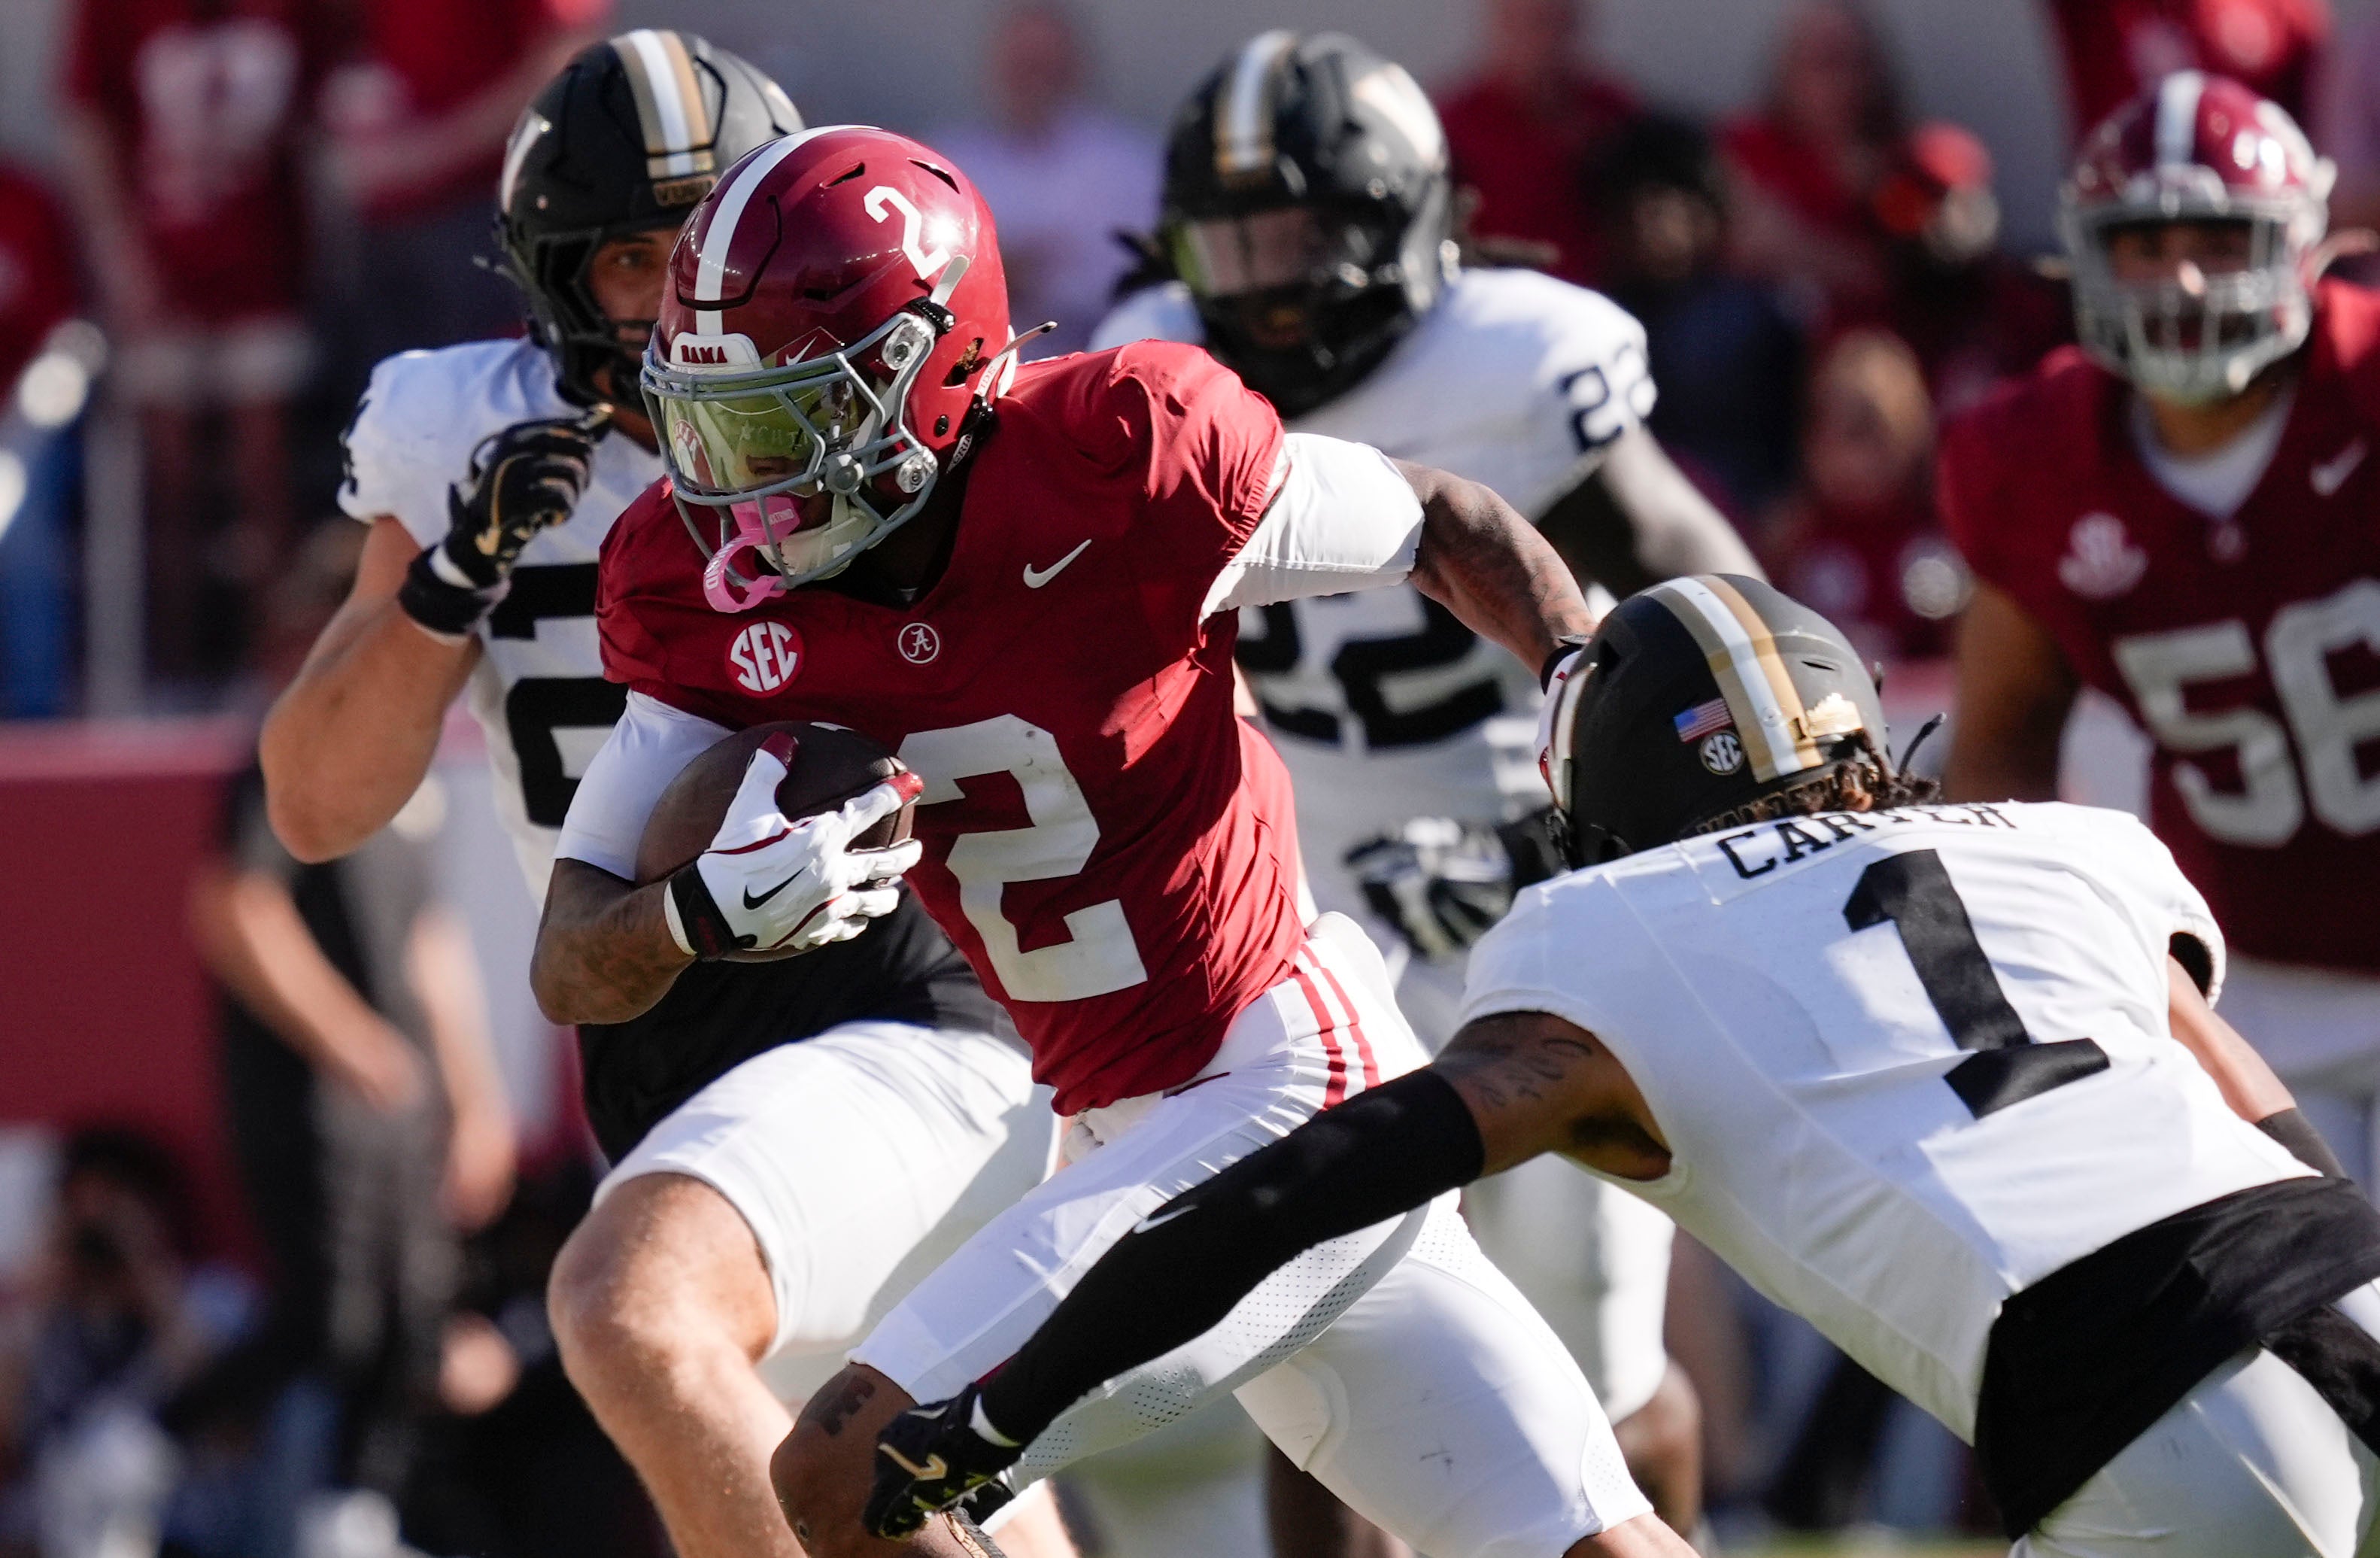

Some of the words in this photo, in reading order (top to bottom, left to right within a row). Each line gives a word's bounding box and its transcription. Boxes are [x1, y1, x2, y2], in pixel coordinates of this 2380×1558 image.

[864, 186, 950, 280] 2
[681, 345, 727, 363] BAMA
[730, 621, 798, 692] SEC
[1704, 733, 1743, 771] SEC
[2113, 578, 2380, 848] 56
[897, 713, 1147, 1003] 2
[1842, 849, 2111, 1119] 1
